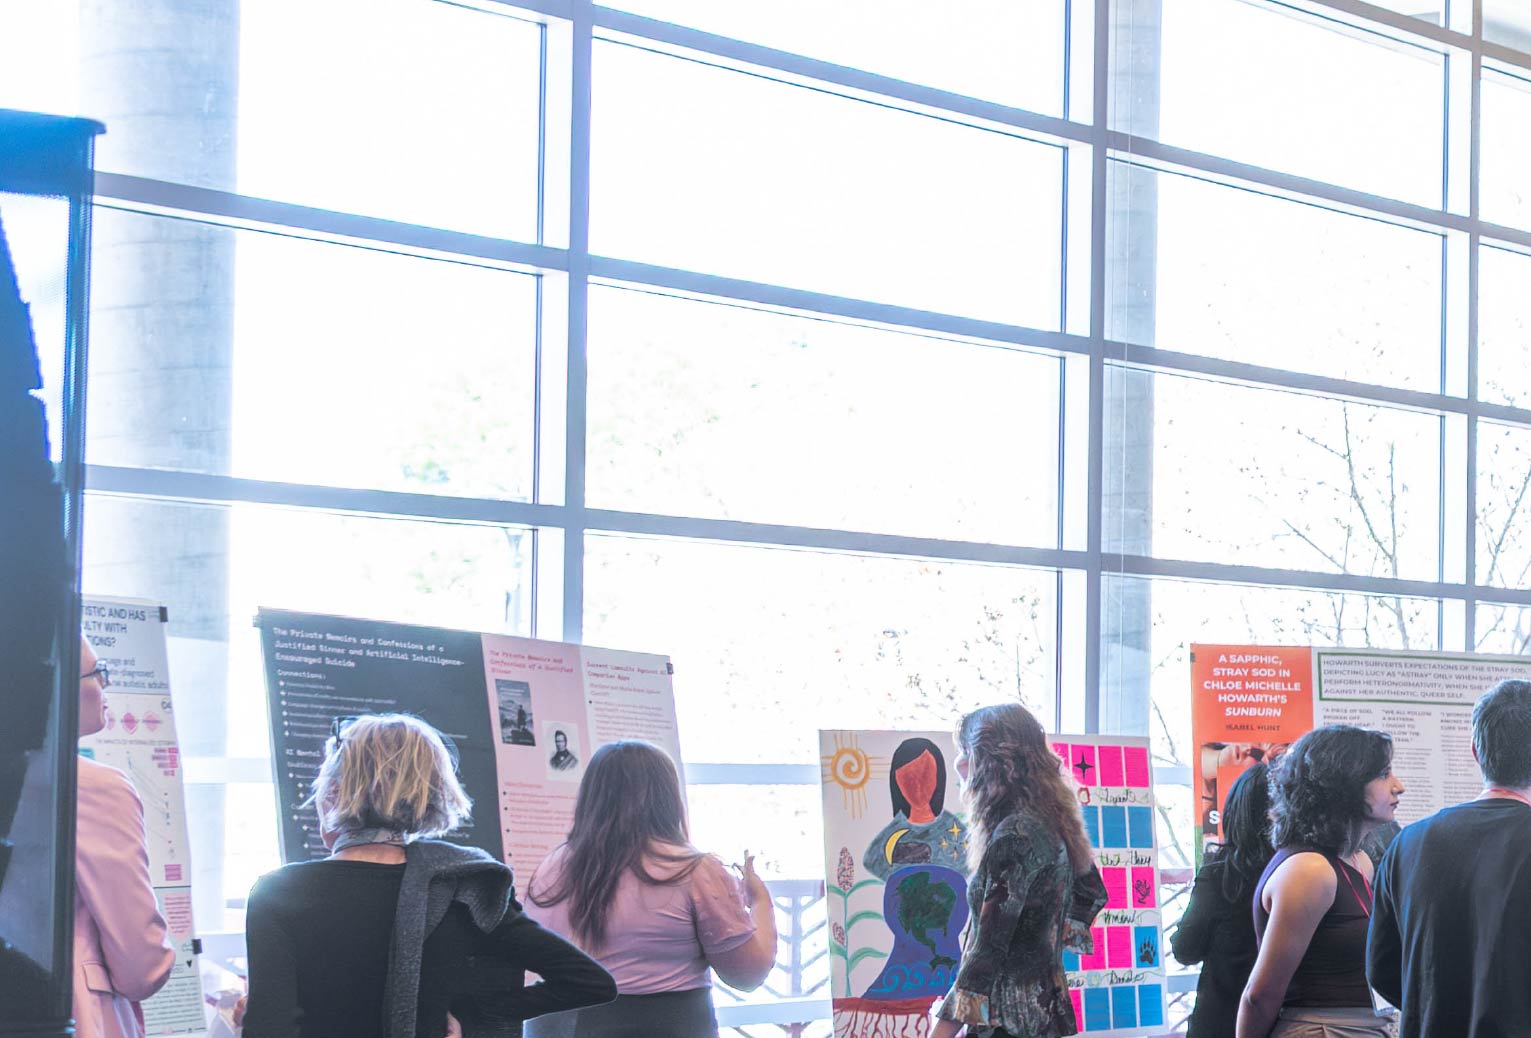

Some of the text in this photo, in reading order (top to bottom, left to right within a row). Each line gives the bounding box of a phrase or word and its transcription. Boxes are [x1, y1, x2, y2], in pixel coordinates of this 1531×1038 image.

[108, 608, 127, 619] AND
[128, 609, 146, 620] HAS
[273, 627, 288, 636] The
[289, 629, 323, 640] Private
[326, 632, 357, 644] Memoirs
[360, 637, 375, 646] and
[377, 638, 424, 651] Confessions
[274, 641, 465, 667] Justified Sinner and Artificial Intelligence-
[275, 652, 356, 668] Encouraged Suicide
[1218, 654, 1283, 666] A SAPPHIC,
[1213, 667, 1291, 678] STRAY SOD IN
[1323, 659, 1364, 668] HOWARTH
[1364, 660, 1403, 669] SUBVERTS
[1404, 661, 1459, 672] EXPECTATIONS
[1460, 663, 1470, 671] OF
[1471, 664, 1486, 673] THE
[1486, 665, 1509, 674] STRAY
[1323, 669, 1364, 677] DEPICTING
[1365, 670, 1385, 678] LUCY
[1386, 671, 1396, 679] AS
[1433, 673, 1453, 681] ONLY
[1454, 674, 1478, 682] WHEN
[1203, 680, 1302, 692] CHLOE MICHELLE
[1323, 679, 1362, 687] PERFORM
[1445, 683, 1469, 691] WHEN
[1218, 693, 1288, 704] HOWARTH'S
[1324, 688, 1357, 696] AGAINST
[1358, 689, 1375, 697] HER
[1420, 690, 1446, 699] QUEER
[1225, 707, 1282, 718] SUNBURN
